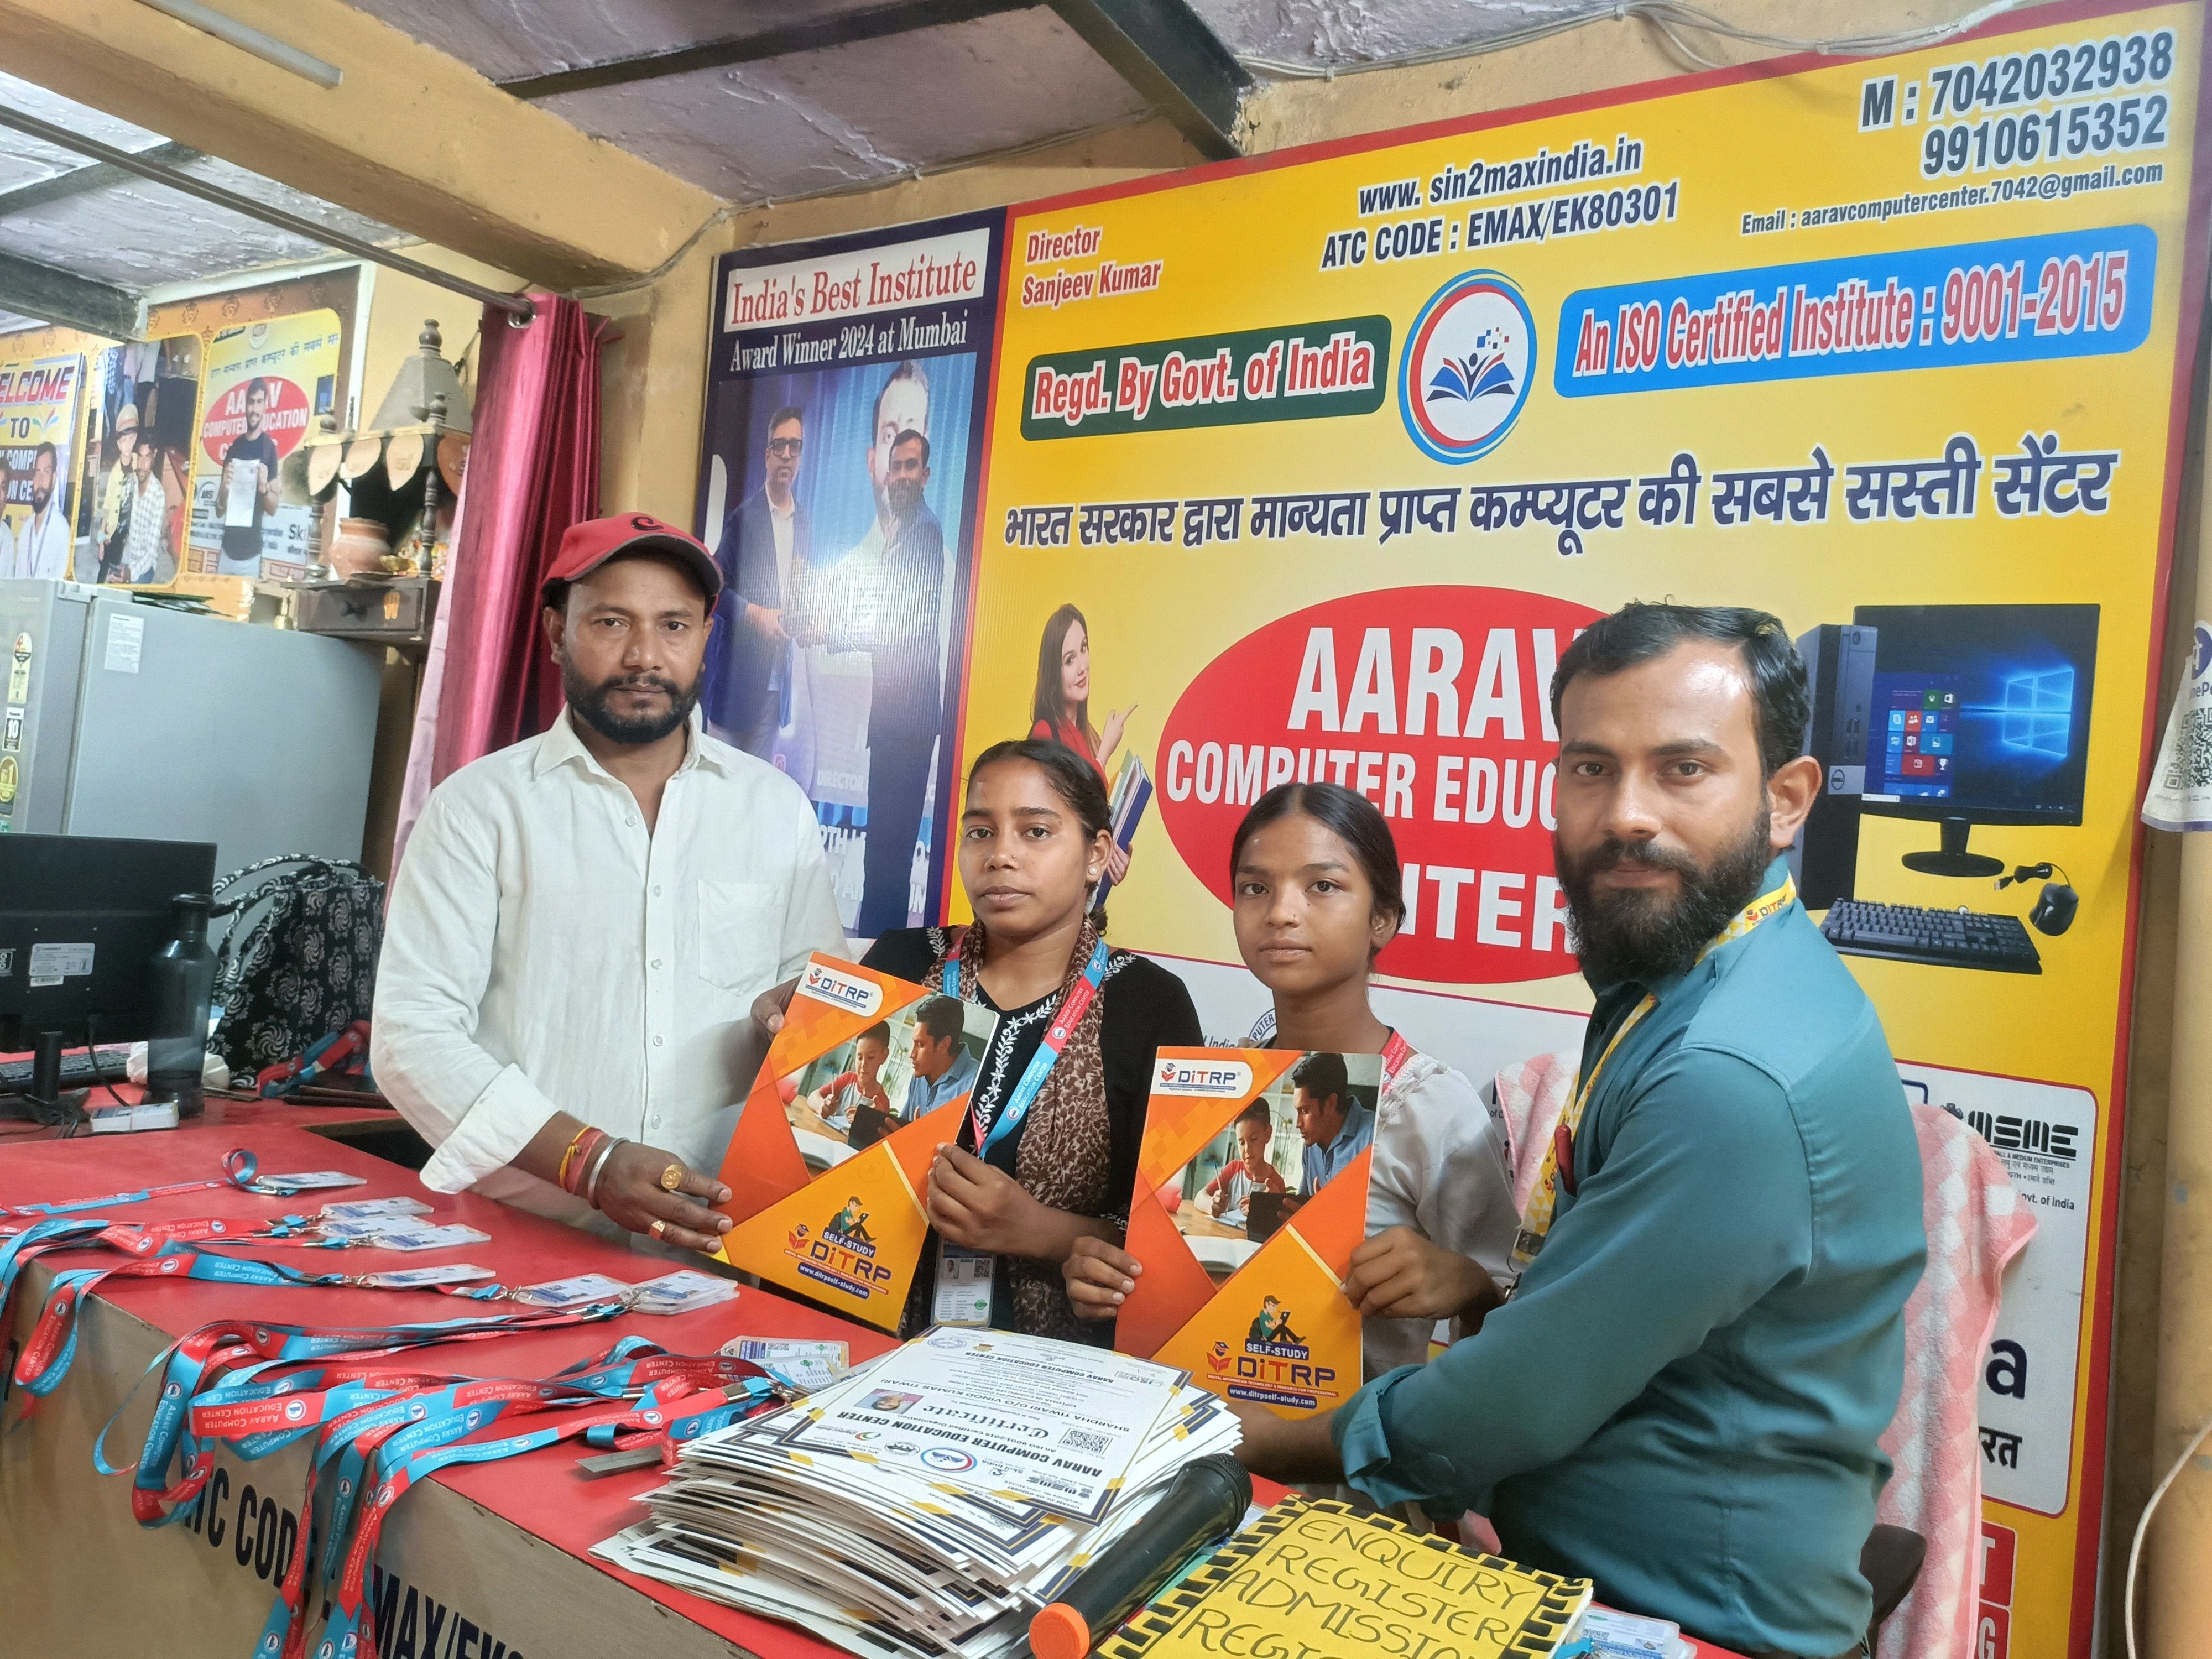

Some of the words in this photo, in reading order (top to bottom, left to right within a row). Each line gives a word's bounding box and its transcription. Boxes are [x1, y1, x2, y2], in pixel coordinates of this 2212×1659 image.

[1862, 80, 1895, 127] M
[1930, 31, 2173, 116] 7042032938
[1924, 95, 2167, 175] 9910615352
[1360, 180, 1421, 213] www.
[1430, 138, 1641, 201] sin2maxindia.in
[1741, 210, 1785, 234] Email
[1801, 163, 2163, 226] aaravcomputercenter.7042@gmail.com
[1322, 231, 1366, 267] ATC
[1376, 221, 1440, 259] CODE
[1468, 182, 1678, 245] EMAX/EK80301
[1028, 226, 1099, 263] Director
[732, 273, 805, 325] India's
[810, 268, 860, 315] Best
[866, 254, 977, 306] Institute
[1022, 272, 1093, 309] Sanjeev
[1100, 260, 1160, 292] Kumar
[1575, 313, 1606, 372] An
[1616, 302, 1661, 367] ISO
[1668, 291, 1785, 365] Certified
[1791, 280, 1912, 353] Institute
[1943, 257, 2126, 339] 9001-2015
[731, 338, 778, 372] Award
[782, 331, 836, 365] Winner
[839, 325, 874, 348] 2024
[878, 328, 894, 352] at
[898, 309, 967, 351] Mumbai
[0, 366, 75, 403] ELCOME
[1035, 366, 1108, 420] Regd.
[1119, 362, 1156, 415] By
[1163, 354, 1235, 402] Govt.
[1247, 345, 1280, 395] of
[1288, 338, 1370, 391] India
[225, 381, 283, 416] AAV
[11, 416, 30, 439] TO
[7, 450, 36, 472] COMP
[1005, 506, 1072, 546] भारत
[1079, 501, 1178, 545] सरकार
[1183, 498, 1244, 547] द्वारा
[1251, 492, 1370, 539] मान्यता
[1379, 488, 1462, 545] प्राप्त
[1638, 453, 1700, 526] की
[1712, 447, 1834, 524] सबसे
[1845, 437, 1981, 520] सस्ती
[1993, 431, 2117, 514] सेंटर
[8, 719, 19, 739] 10
[817, 770, 864, 791] DIRECTOR
[1167, 739, 1416, 819] COMPUTER
[1397, 864, 1573, 954] NTER
[1059, 1006, 1071, 1024] AARAV
[1068, 987, 1084, 1009] COMPUTER
[1065, 1004, 1080, 1029] EDUCATION
[1078, 989, 1090, 1006] CENTER
[1252, 1014, 1274, 1041] PUTER
[1014, 1086, 1026, 1103] AARAV
[1023, 1060, 1040, 1087] COMPUTER
[1019, 1082, 1035, 1108] EDUCATION
[1034, 1062, 1048, 1083] CENTER
[1968, 1110, 2079, 1158] MSME
[2012, 1154, 2033, 1162] MEDIUM
[2033, 1157, 2070, 1168] ENTERPRISES
[2041, 1194, 2051, 1205] of
[2052, 1196, 2074, 1210] India
[823, 1231, 874, 1257] SELF-STUDY
[800, 1264, 868, 1296] www.ditrpself-study.com
[1246, 1343, 1308, 1359] SELF-STUDY
[646, 1360, 674, 1368] CENTER
[996, 1357, 1039, 1368] EDUCATION
[1039, 1365, 1084, 1377] COMPUTER
[375, 1378, 406, 1387] CENTER
[466, 1387, 494, 1397] CENTER
[495, 1384, 536, 1392] EDUCATION
[880, 1378, 920, 1388] TIWARI
[922, 1384, 963, 1395] KUMAR
[948, 1380, 994, 1391] APPLICATION
[1307, 1389, 1337, 1397] PROFESSIONAL
[966, 1392, 1002, 1404] VINOD
[1004, 1400, 1028, 1409] D/O
[1229, 1388, 1316, 1406] www.ditrpself-study.com
[165, 1405, 176, 1430] AARAV
[202, 1409, 231, 1418] CENTER
[234, 1402, 282, 1416] EDUCATION
[249, 1413, 279, 1425] AARAV
[360, 1406, 405, 1425] EDUCATION
[836, 1411, 890, 1426] CENTER
[1030, 1405, 1070, 1419] TIWARI
[148, 1400, 168, 1441] EDUCATION
[205, 1418, 247, 1429] COMPUTER
[424, 1414, 465, 1432] EDUCATION
[442, 1425, 463, 1436] AARAV
[897, 1415, 947, 1428] Organization
[922, 1405, 1049, 1439] Certificate
[948, 1425, 984, 1436] Certified
[1074, 1416, 1130, 1432] SHARDHA
[249, 1430, 290, 1454] COMPUTER
[392, 1429, 424, 1447] CENTER
[400, 1433, 441, 1451] COMPUTER
[891, 1421, 970, 1443] EDUCATION
[138, 1442, 154, 1470] CENTER
[152, 1431, 170, 1467] COMPUTER
[971, 1438, 1050, 1463] COMPUTER
[1052, 1458, 1103, 1477] AARAV
[1298, 1519, 1536, 1610] ENQUIRY
[1266, 1543, 1511, 1646] REGISTER
[1217, 1569, 1479, 1659] ADMISSIO
